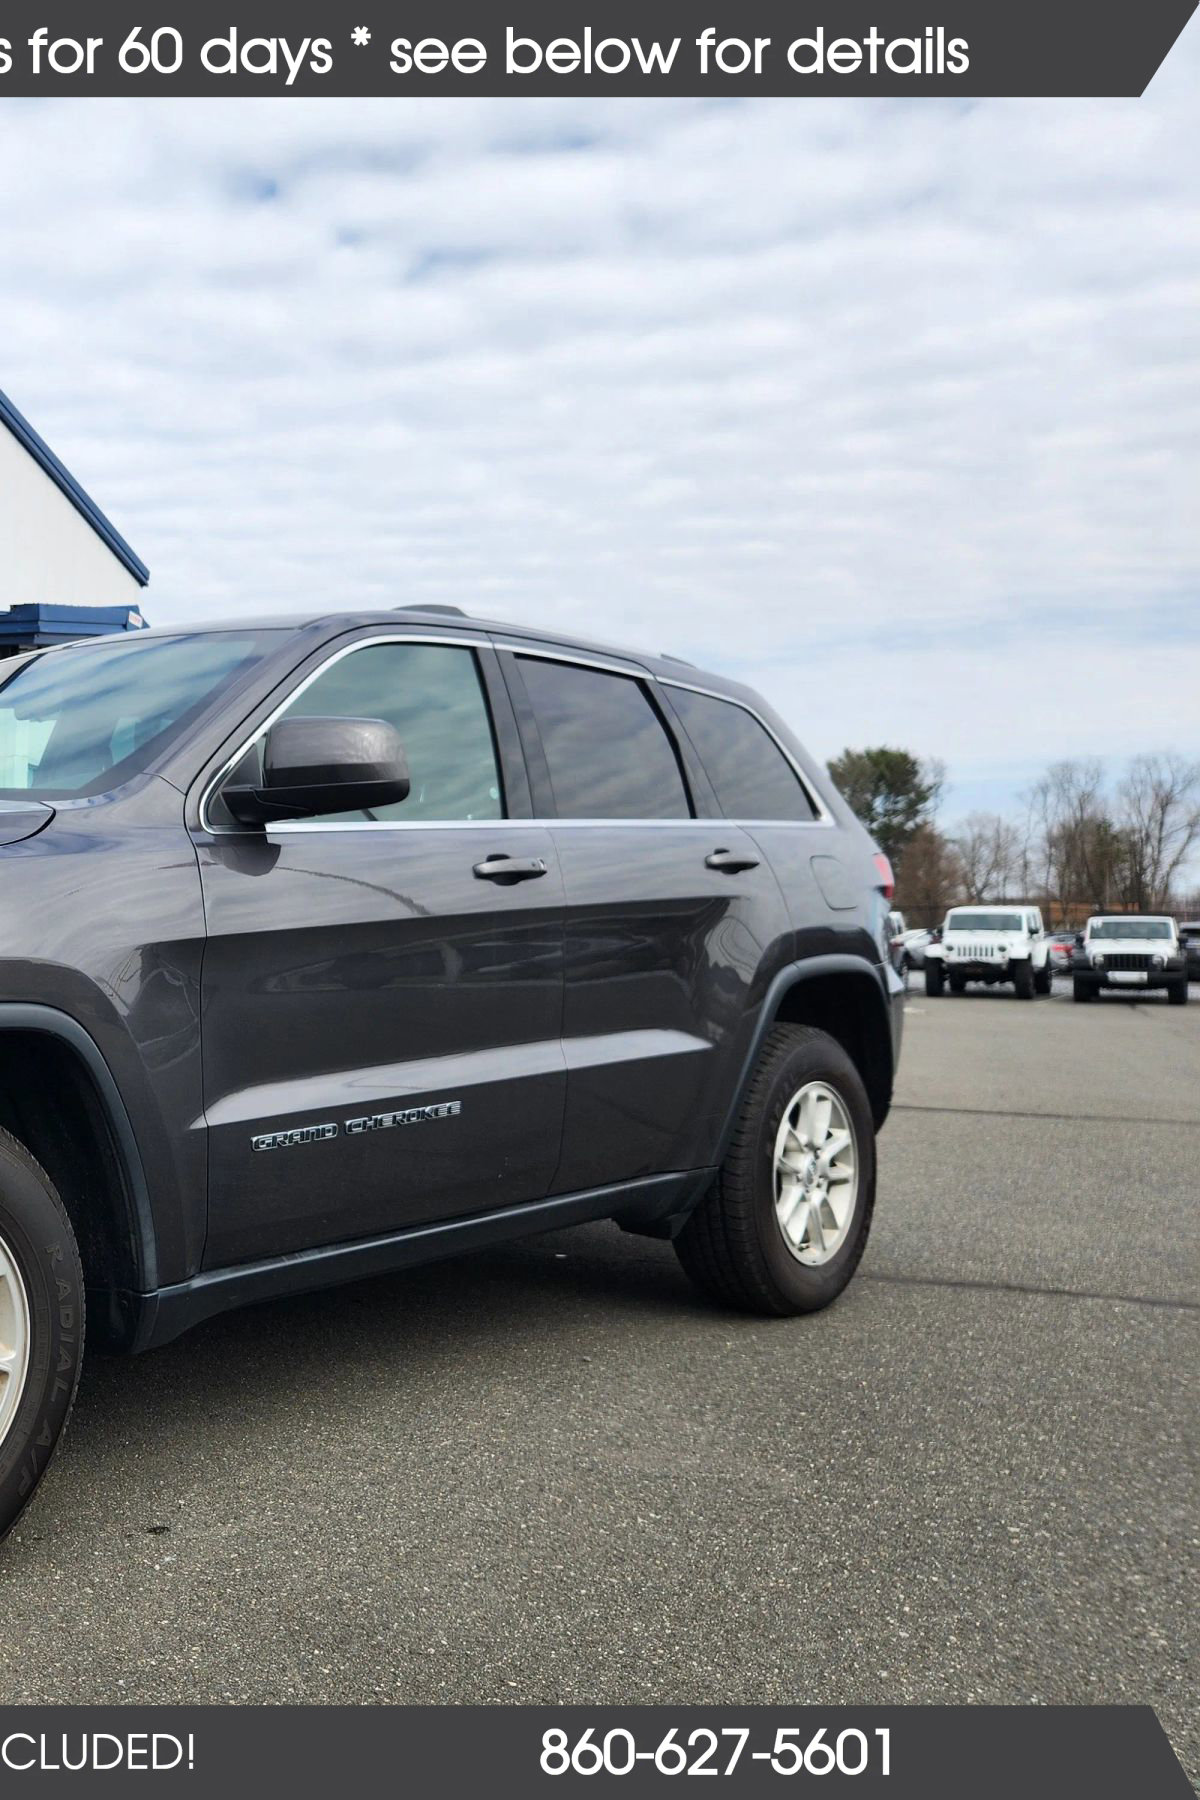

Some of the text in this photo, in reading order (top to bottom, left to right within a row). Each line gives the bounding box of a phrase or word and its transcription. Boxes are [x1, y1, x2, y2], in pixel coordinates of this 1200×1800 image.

[250, 1100, 462, 1152] GRAND CHEROKEE
[46, 1244, 74, 1403] RADIAL
